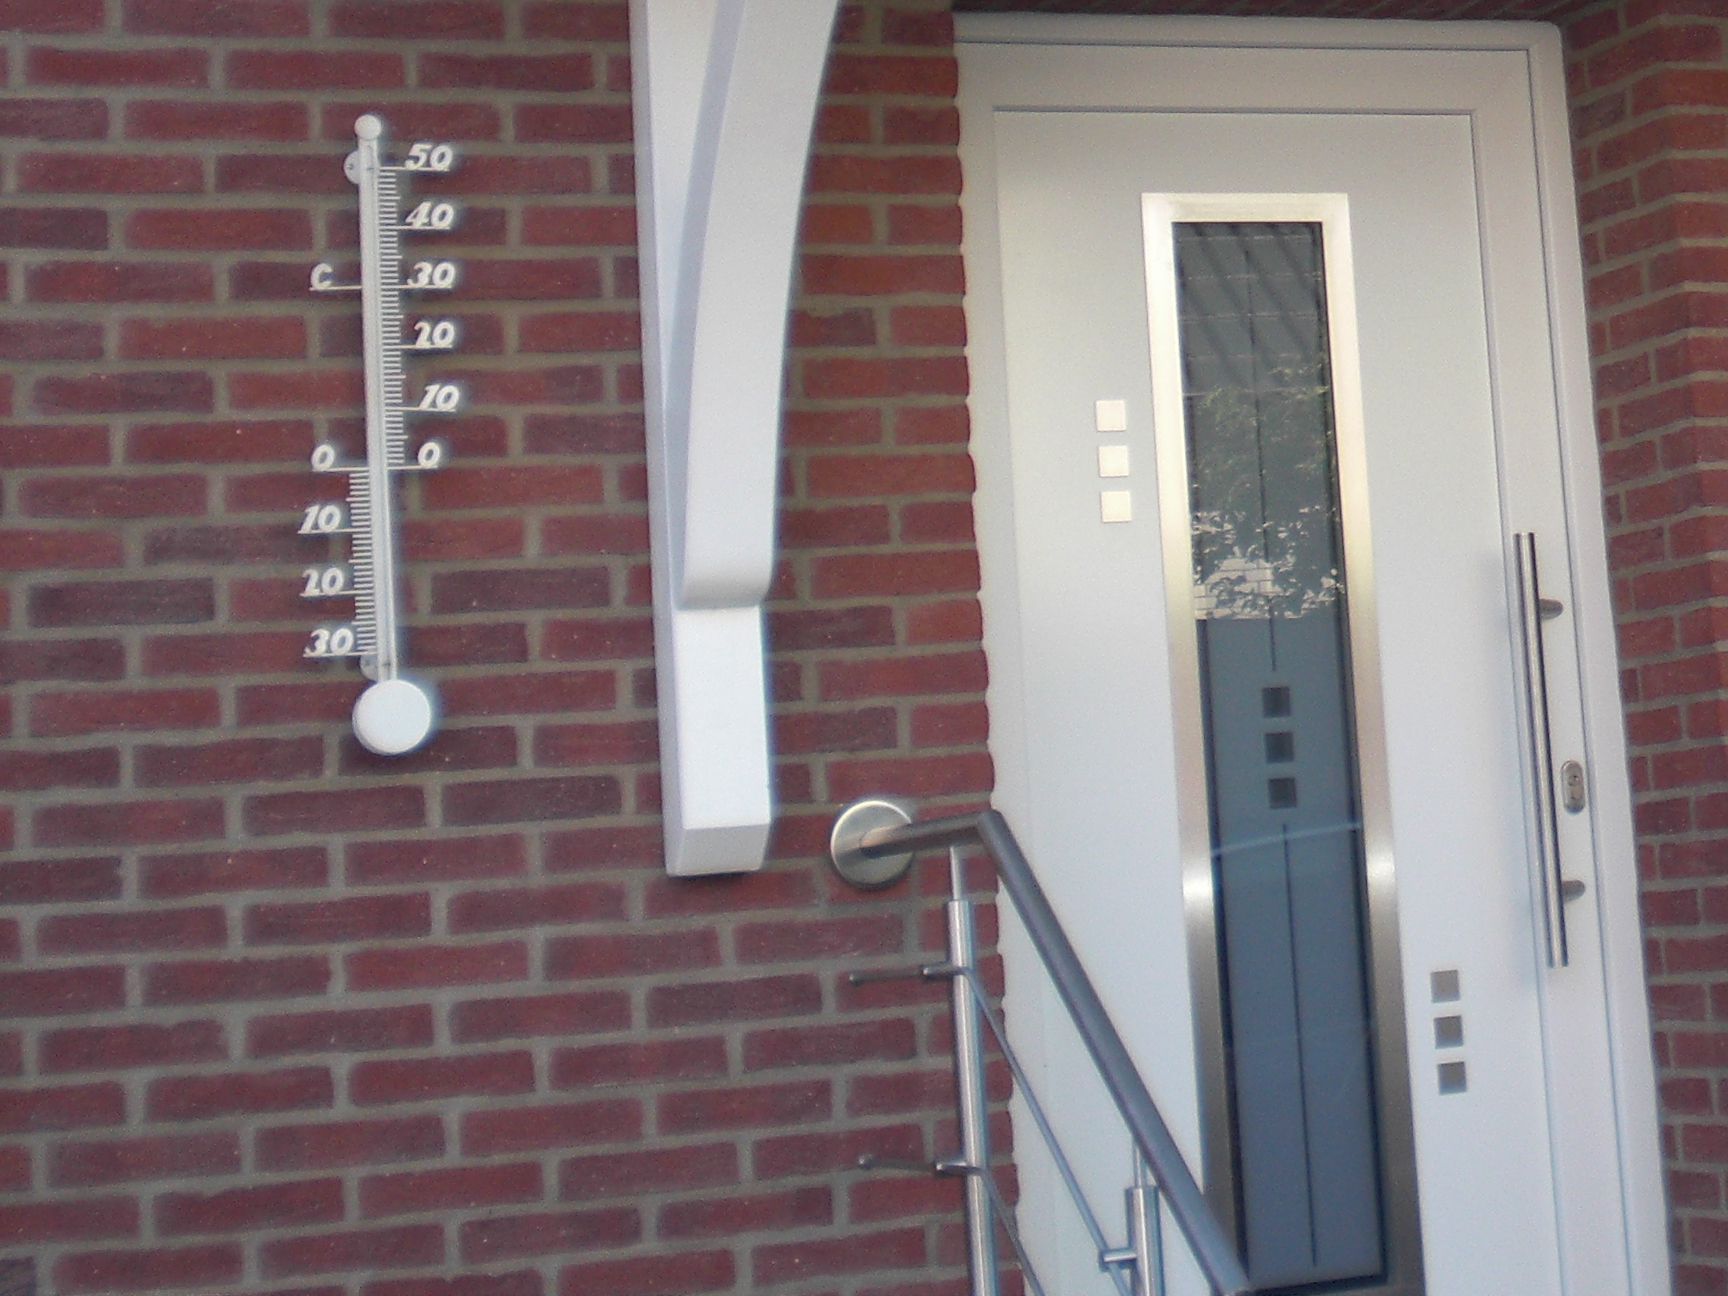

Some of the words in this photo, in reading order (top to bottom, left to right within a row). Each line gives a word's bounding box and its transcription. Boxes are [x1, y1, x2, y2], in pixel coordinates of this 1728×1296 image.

[404, 143, 453, 170] 50
[405, 201, 455, 229] 40
[407, 262, 456, 288] 30
[413, 321, 456, 347] 20
[417, 384, 460, 411] 10
[311, 444, 336, 471] 0
[417, 441, 441, 467] 0
[300, 505, 342, 533] 10
[302, 567, 344, 596] 20
[304, 628, 354, 655] 30
